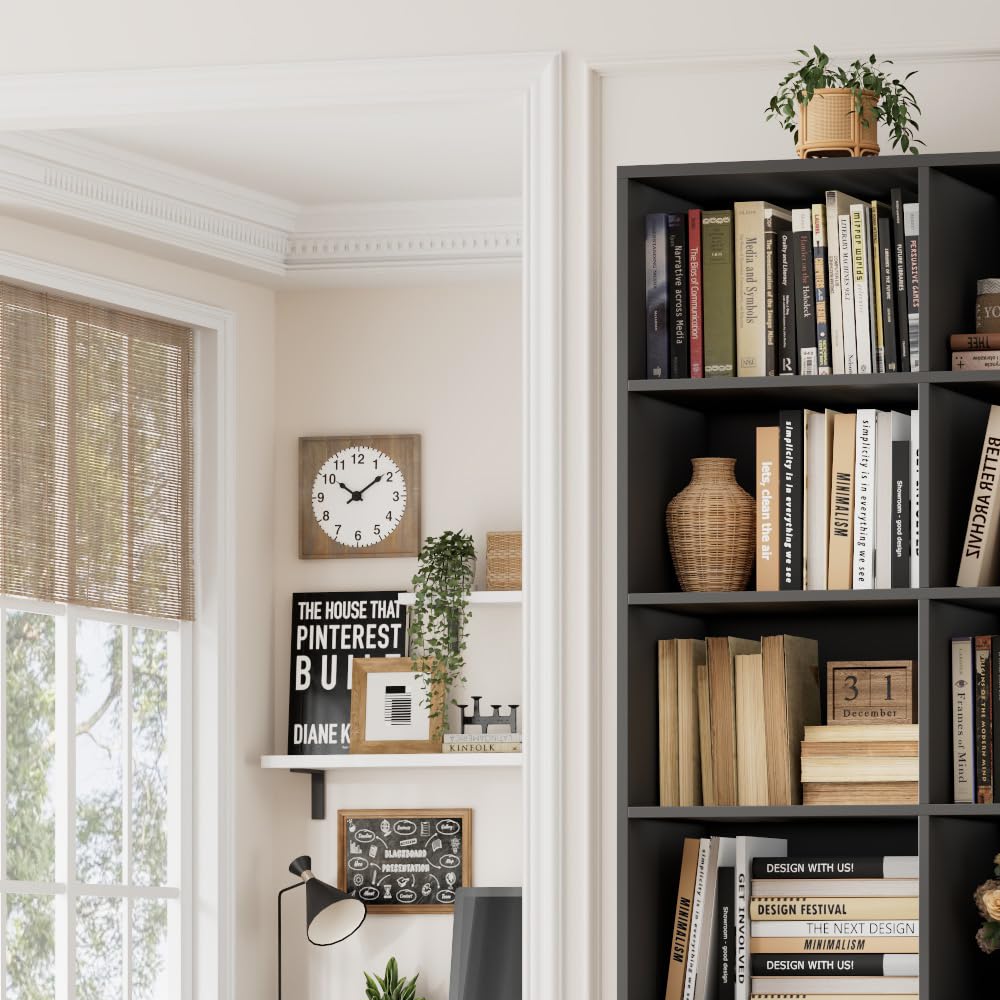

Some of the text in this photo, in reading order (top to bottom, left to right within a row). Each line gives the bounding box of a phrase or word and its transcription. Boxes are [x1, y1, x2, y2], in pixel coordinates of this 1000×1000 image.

[853, 211, 864, 281] mirror worlds
[691, 260, 699, 275] Bios
[744, 236, 758, 324] Media and Symbols
[674, 245, 684, 345] Narrative across Media
[690, 284, 699, 340] Communication
[967, 336, 990, 349] THEE
[333, 459, 345, 470] 11
[351, 453, 365, 464] 12
[372, 459, 378, 470] 1
[322, 473, 336, 485] 10
[386, 472, 393, 482] 2
[317, 492, 325, 503] 9
[392, 491, 400, 502] 3
[783, 420, 793, 584] simplicity is in everything we see
[761, 488, 770, 519] clean
[833, 472, 851, 537] MINIMALISM
[322, 510, 330, 521] 8
[385, 511, 393, 521] 4
[334, 524, 342, 535] 7
[354, 530, 362, 541] 6
[373, 524, 381, 535] 5
[761, 521, 773, 540] the
[761, 541, 773, 561] air
[298, 599, 401, 620] THE HOUSE THAT
[296, 623, 402, 650] PINTEREST
[844, 674, 895, 701] 3 1
[843, 709, 898, 718] December
[293, 723, 338, 745] DIANE
[449, 743, 496, 752] KINFOLK
[384, 849, 427, 859] BLACKBOARD
[381, 864, 430, 873] PRESENTATION
[766, 863, 854, 873] DESIGN WITH US!
[757, 903, 847, 916] DESIGN FESTIVAL
[806, 922, 915, 935] THE NEXT DESIGN
[803, 939, 866, 951] MINIMALISM
[766, 960, 854, 971] DESIGN WITH US!
